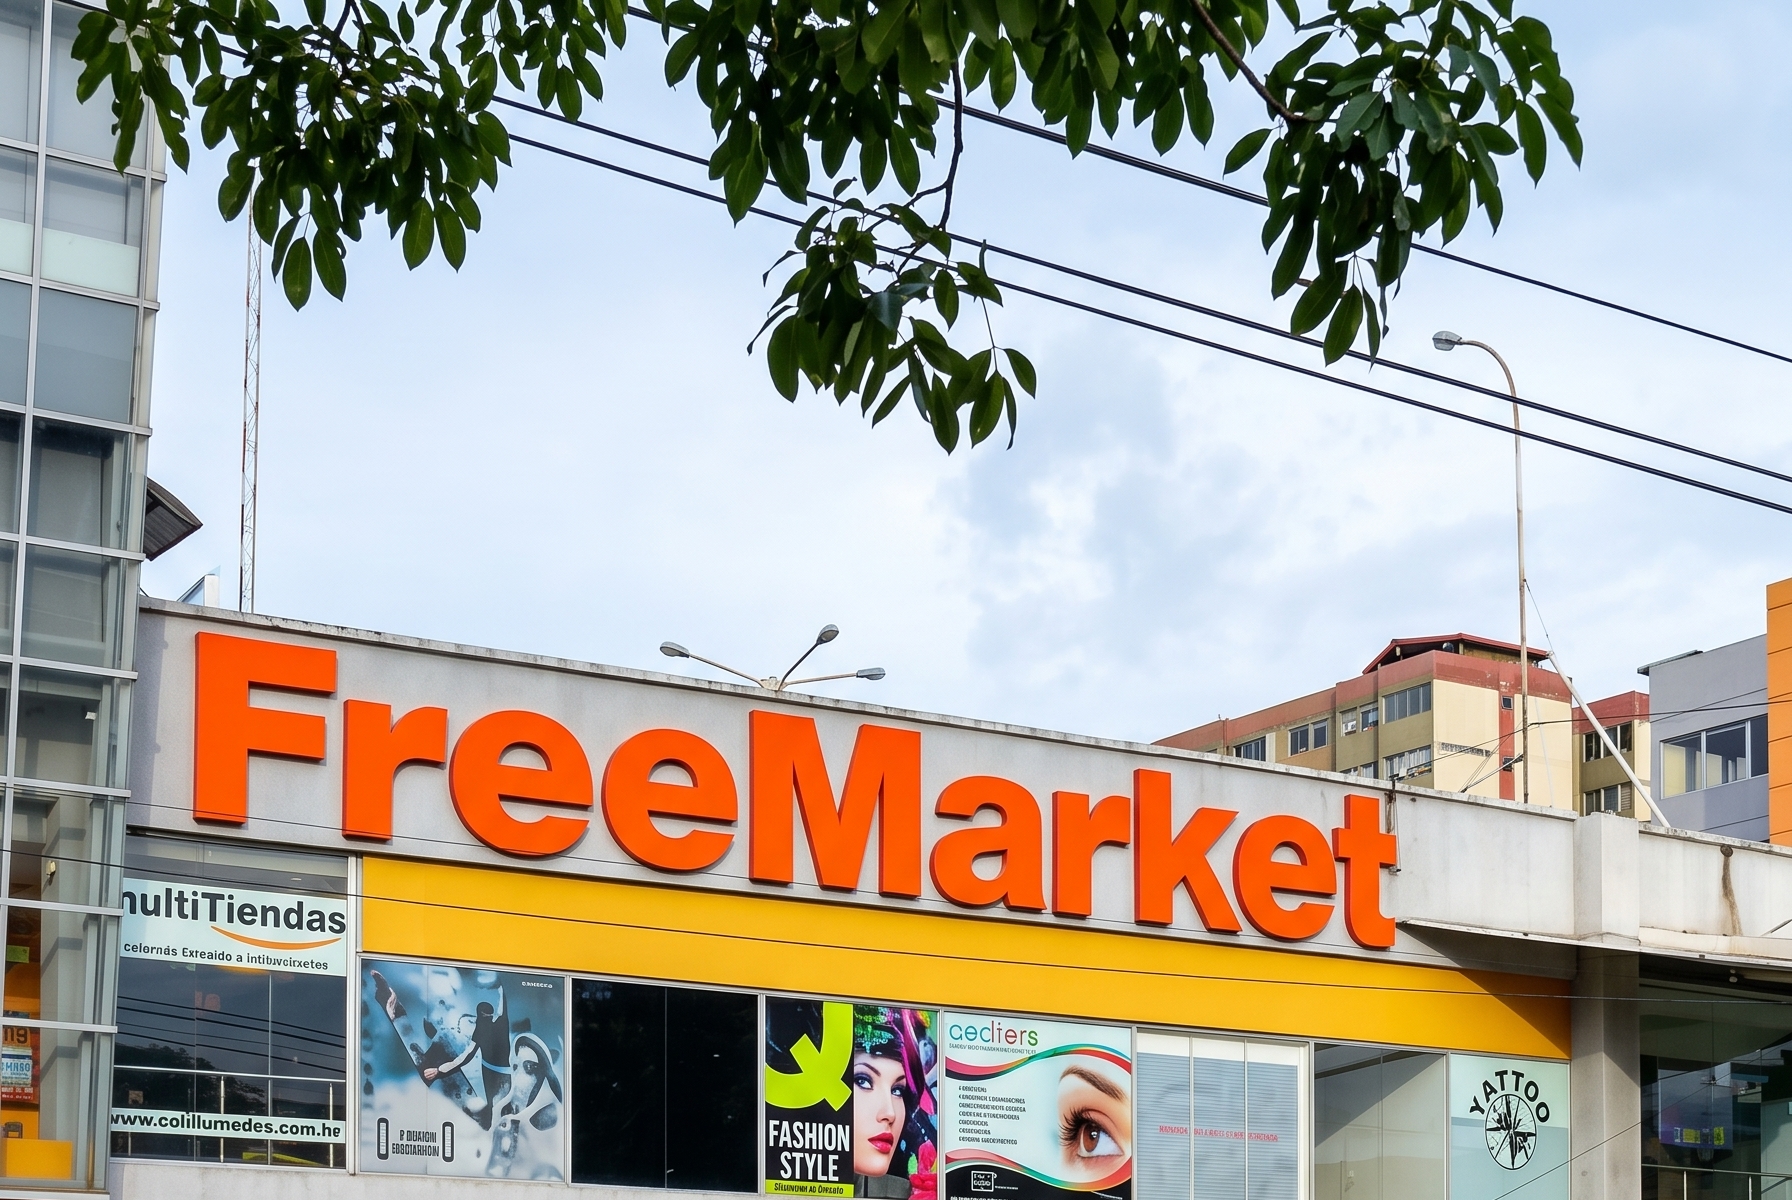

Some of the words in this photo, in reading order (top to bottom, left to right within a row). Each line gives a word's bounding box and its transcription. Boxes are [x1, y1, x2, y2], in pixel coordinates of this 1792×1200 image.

[193, 631, 1397, 949] FreeMarket
[769, 1119, 850, 1151] FASHION
[780, 1152, 839, 1182] STYLE
